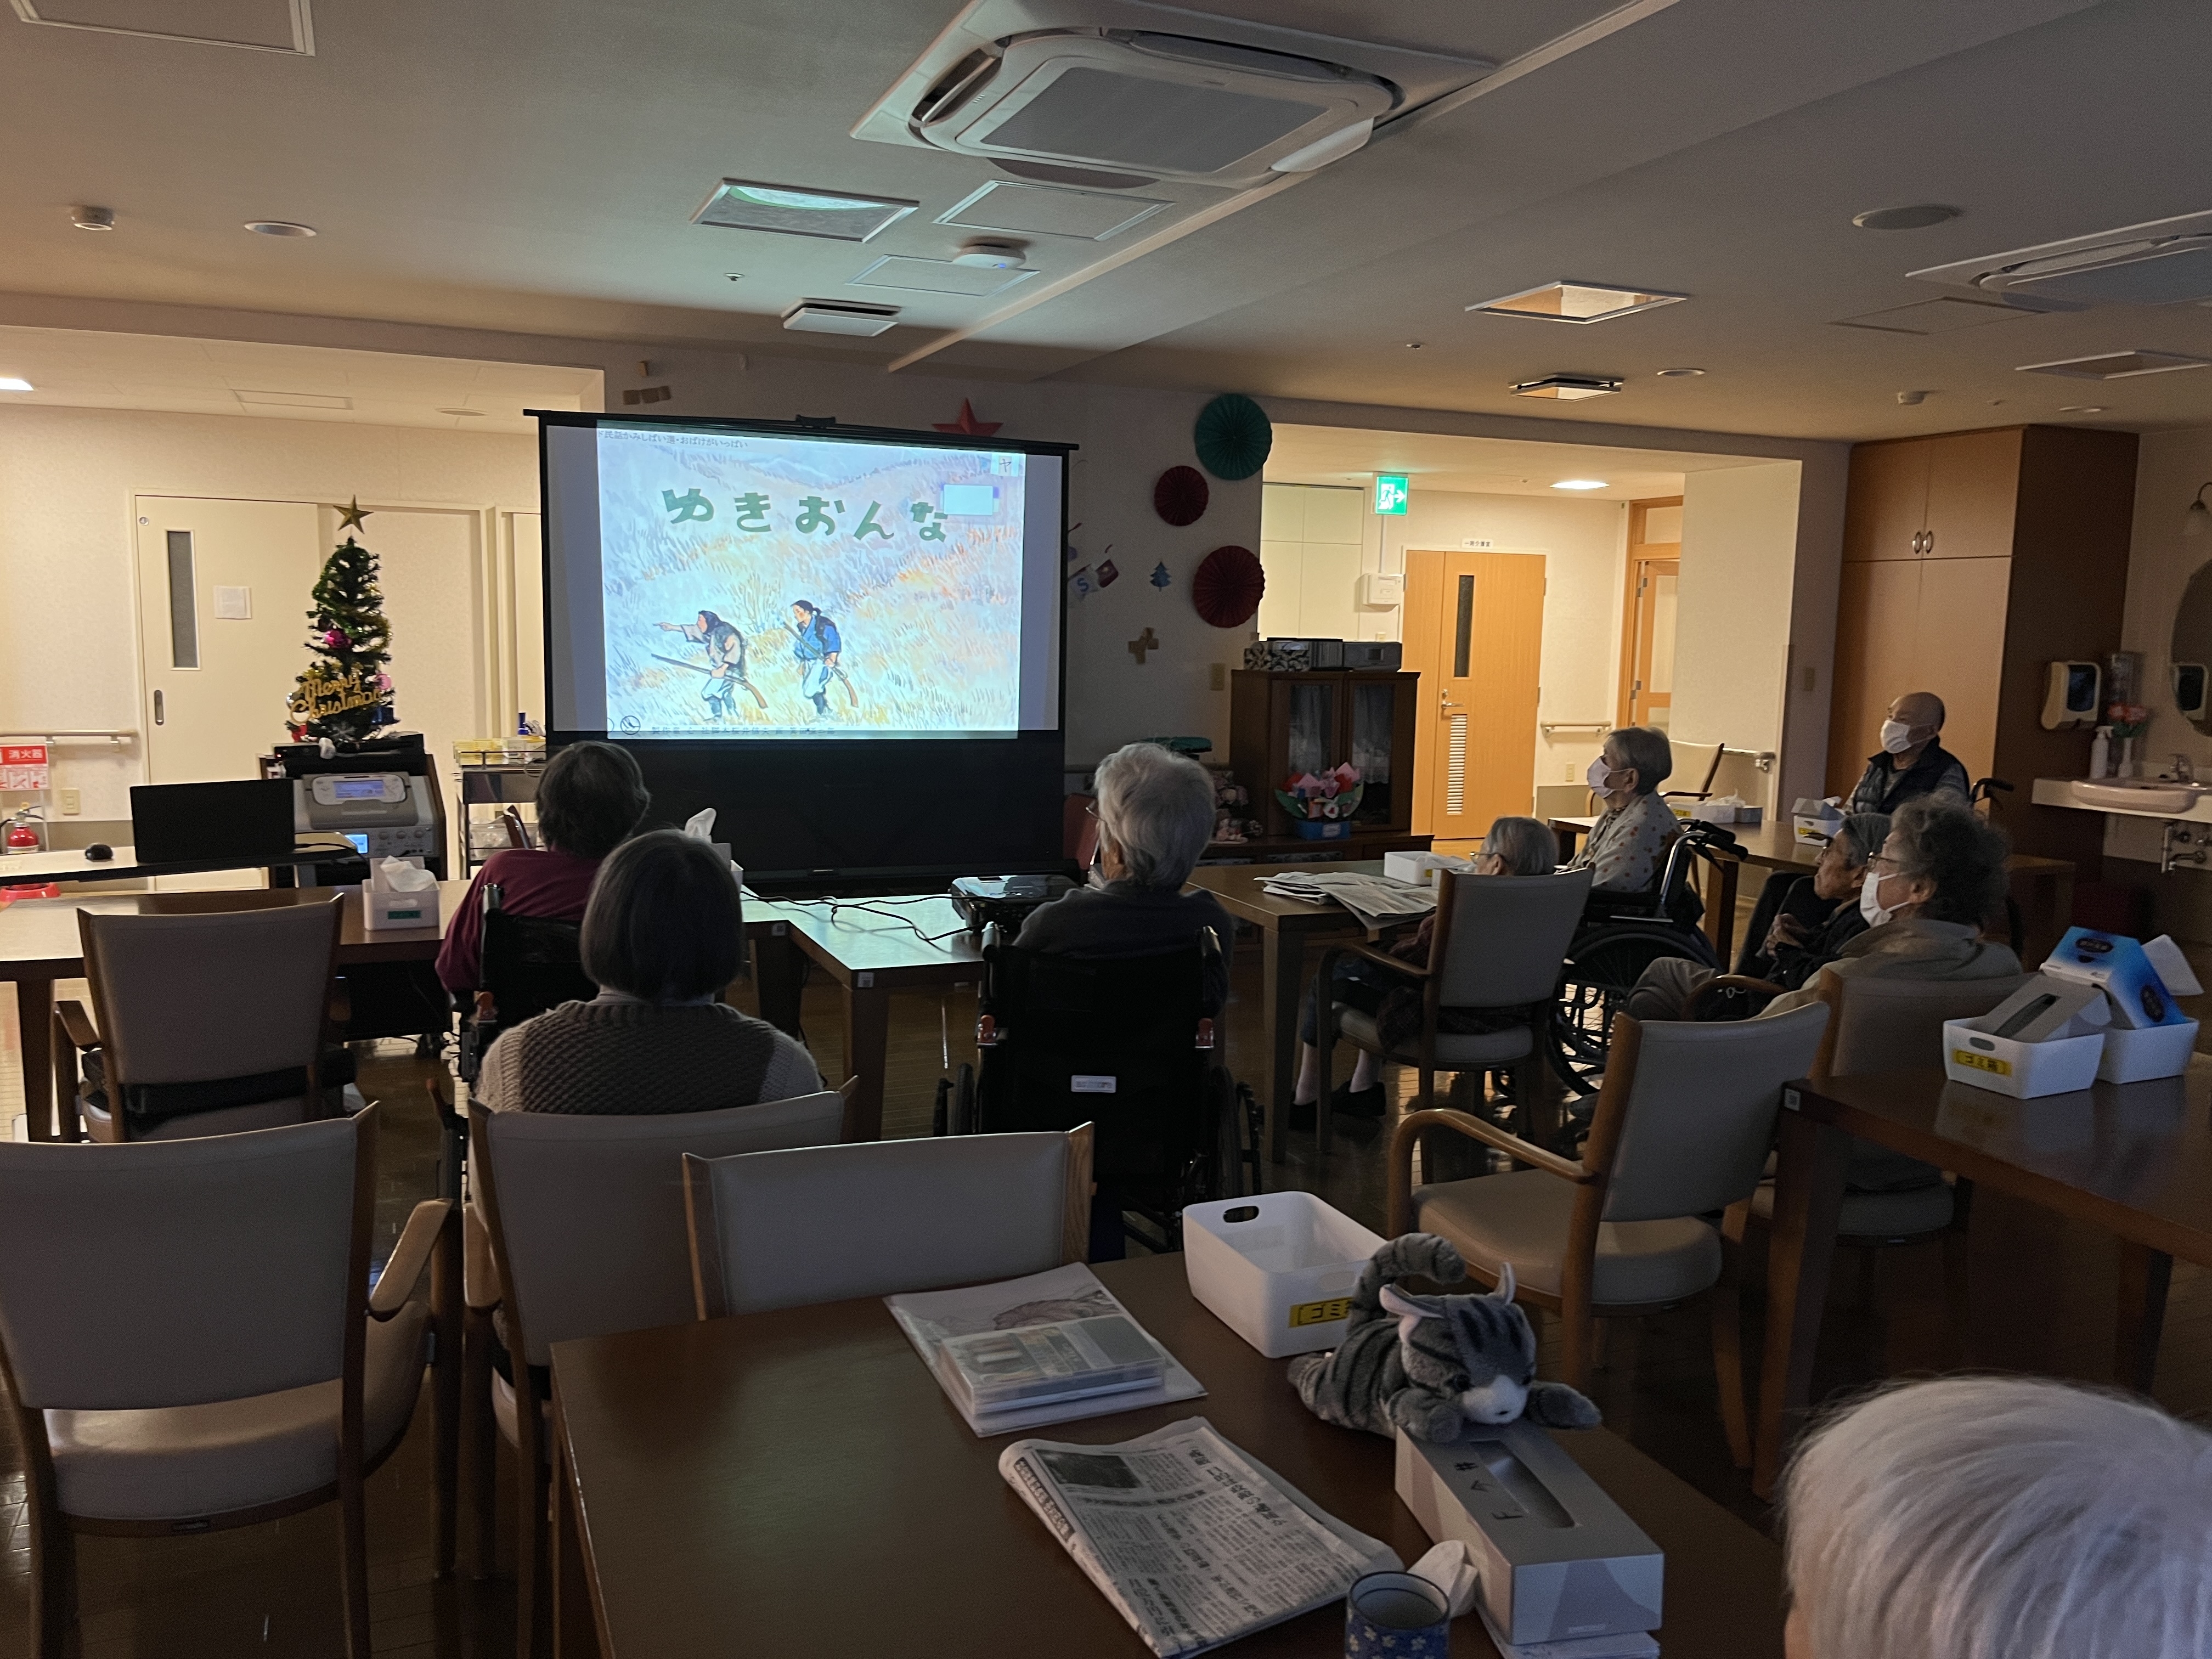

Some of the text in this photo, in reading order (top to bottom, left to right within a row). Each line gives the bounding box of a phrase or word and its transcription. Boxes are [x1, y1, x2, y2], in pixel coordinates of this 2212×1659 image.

[662, 488, 949, 543] ゆきおんな
[1077, 578, 1089, 592] S
[8, 749, 43, 759] 消火器
[1311, 1300, 1351, 1319] ゴミ
